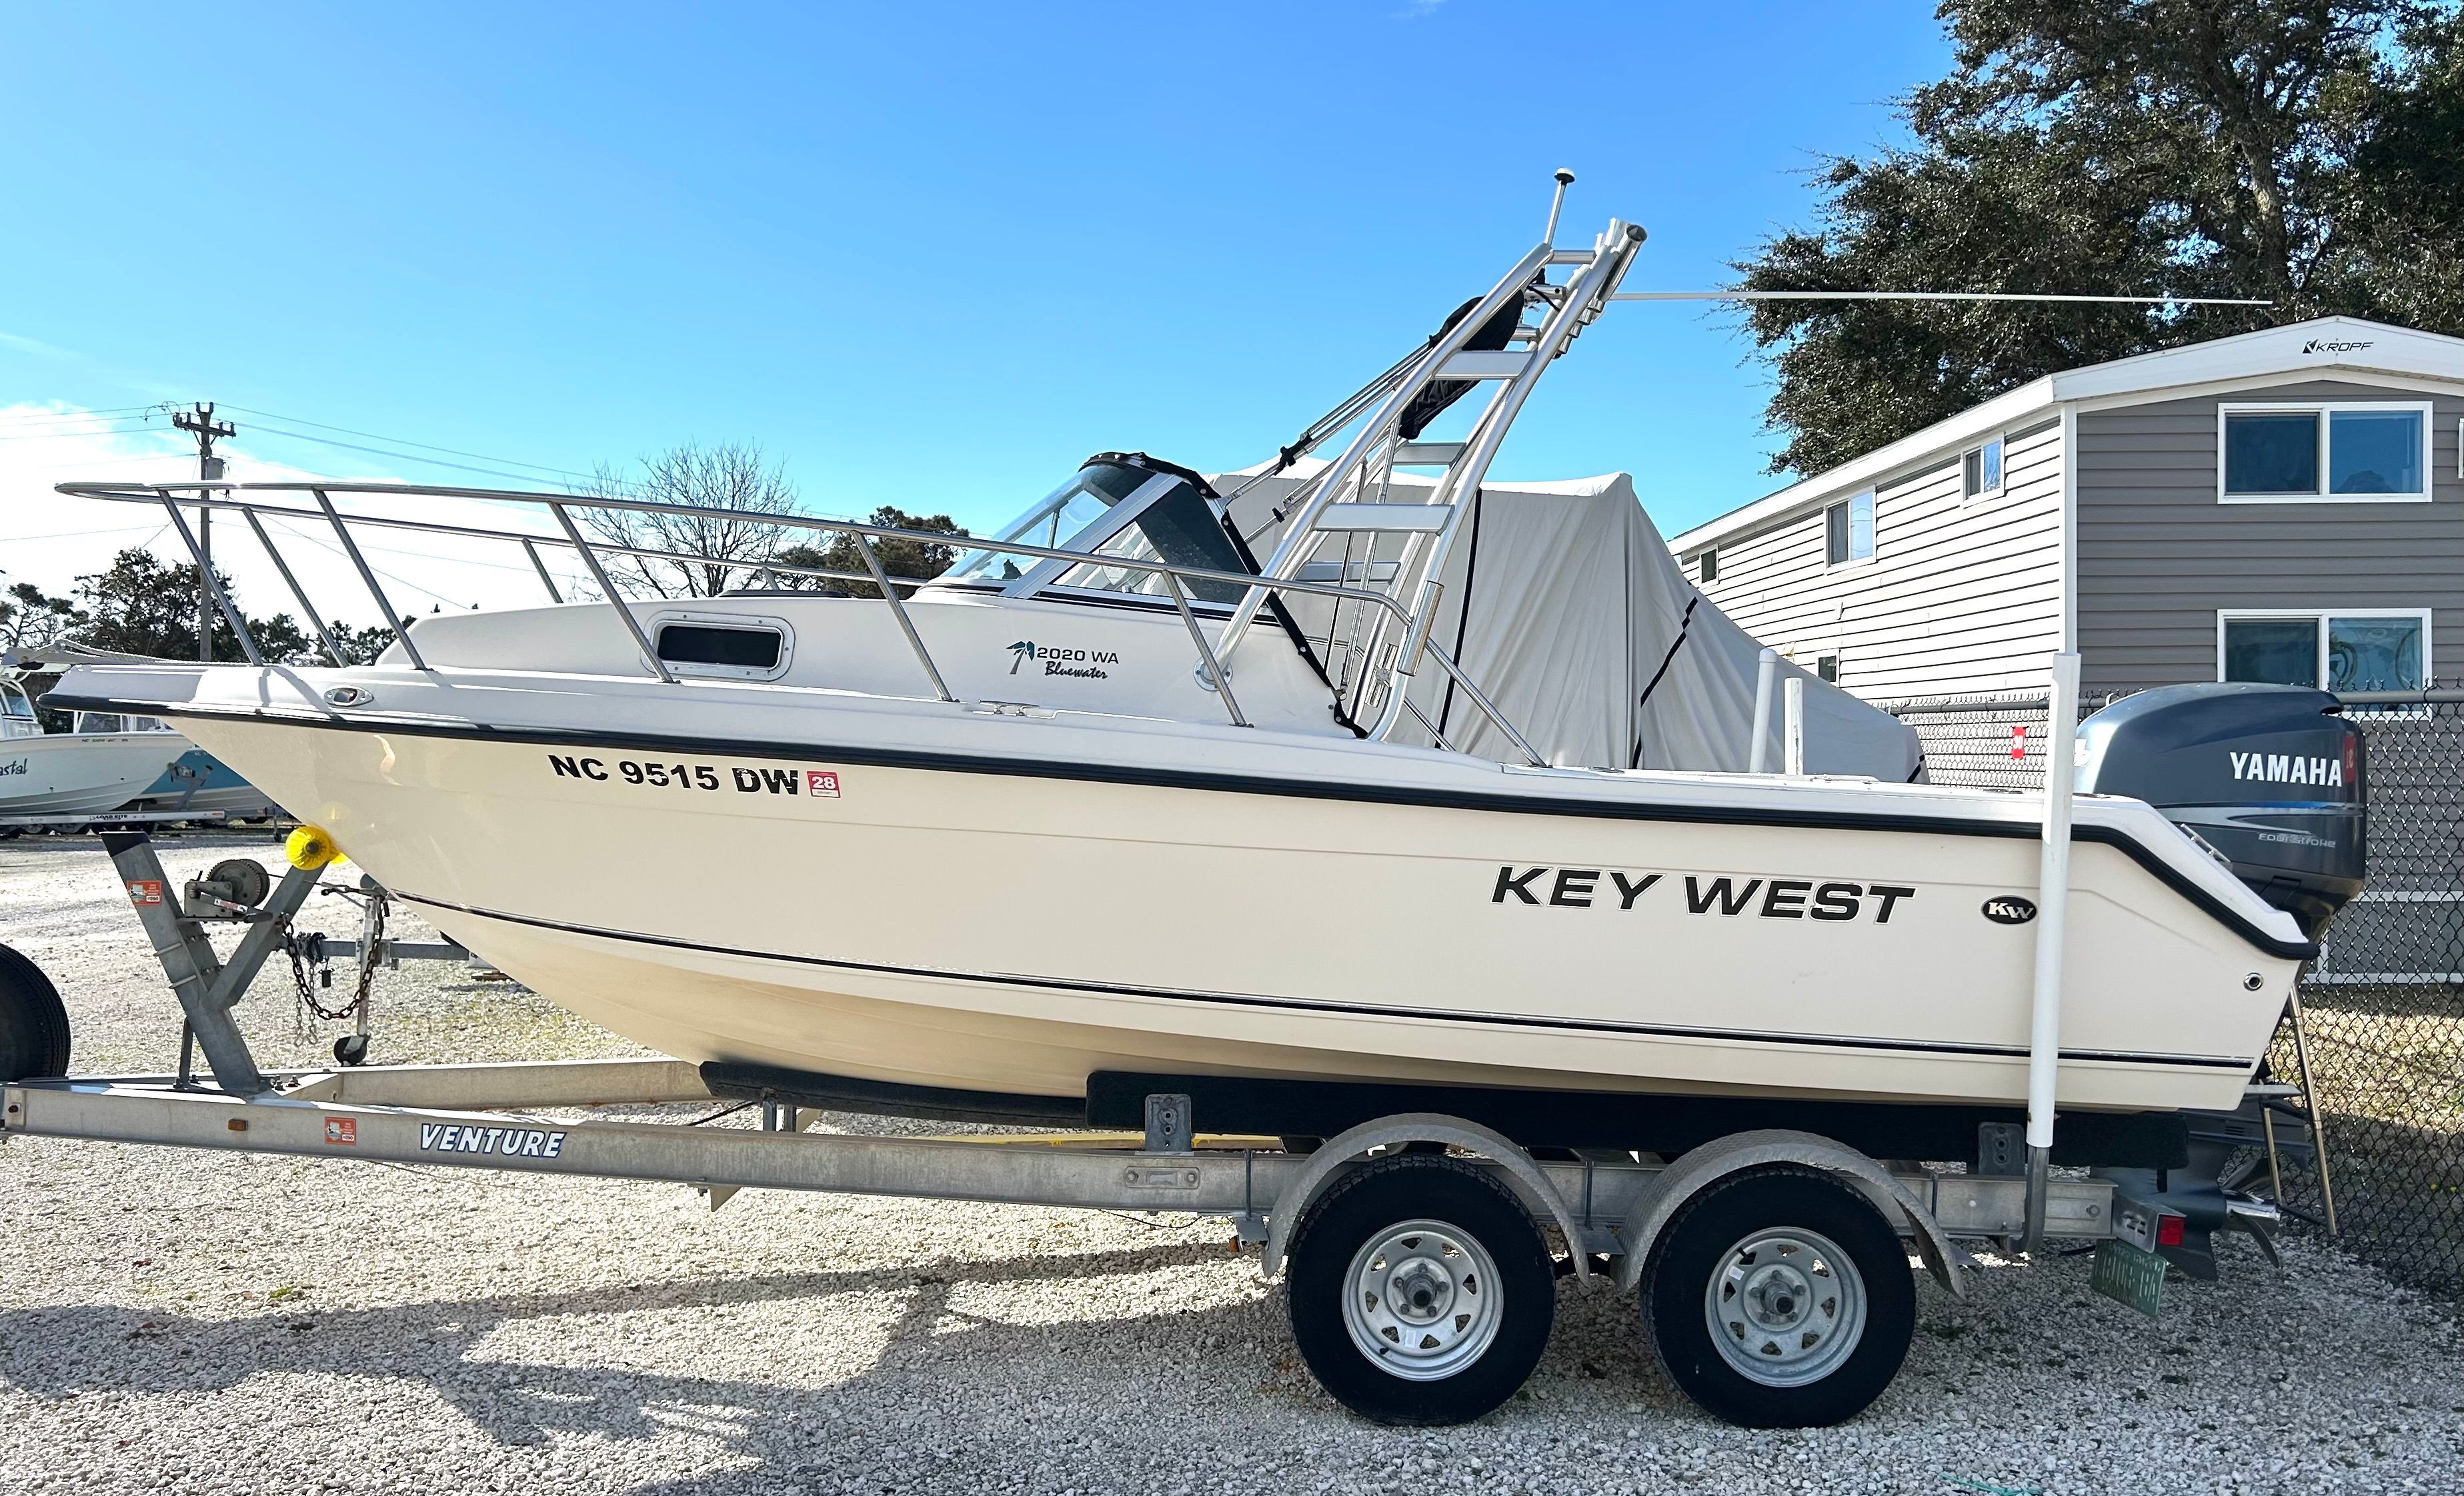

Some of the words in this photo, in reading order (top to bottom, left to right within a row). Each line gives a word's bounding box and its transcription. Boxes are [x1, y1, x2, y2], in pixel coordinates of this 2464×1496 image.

[2316, 341, 2374, 352] KROPF
[1036, 647, 1086, 661] 2020
[1092, 651, 1119, 664] WA
[1045, 661, 1108, 679] Bluewater
[547, 754, 608, 781] NC
[618, 761, 720, 791] 9515
[732, 767, 798, 795] DW
[2229, 751, 2343, 787] YAMAHA
[812, 776, 836, 789] 28
[1490, 864, 1667, 911] KEY
[1682, 874, 1918, 925] WEST
[1988, 901, 2035, 919] KW
[421, 1123, 568, 1159] VENTURE
